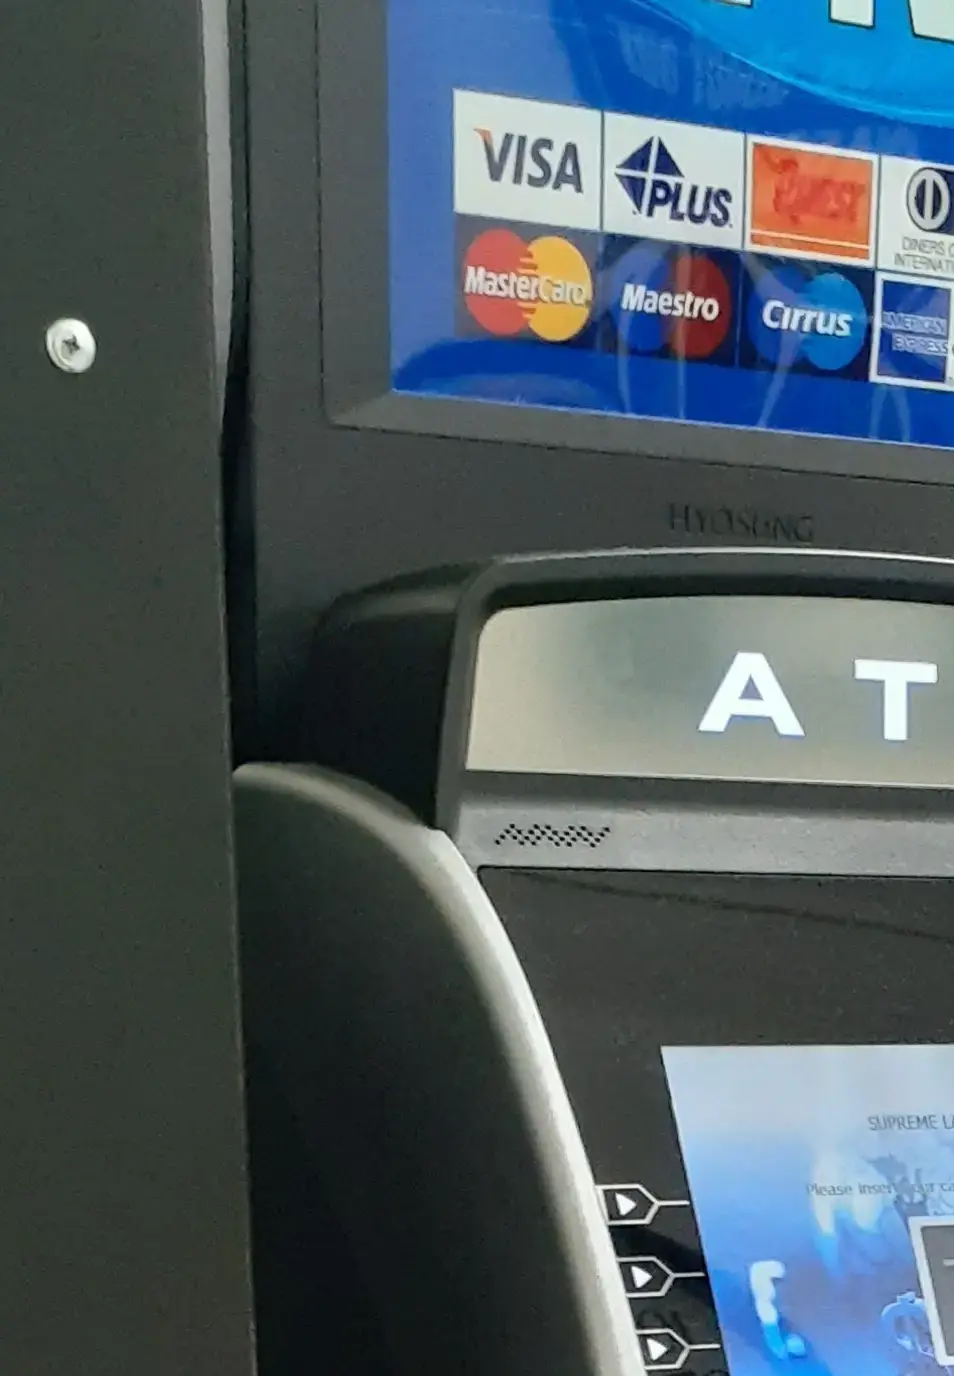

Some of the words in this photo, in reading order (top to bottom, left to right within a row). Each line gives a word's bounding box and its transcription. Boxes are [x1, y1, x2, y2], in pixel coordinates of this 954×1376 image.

[474, 128, 583, 194] VISA
[646, 179, 733, 228] PLUS
[464, 266, 590, 306] MasterCard
[621, 284, 719, 321] Maestro
[762, 300, 853, 336] Cirrus
[668, 503, 813, 542] HYOSUNG
[868, 1114, 940, 1131] SUPREME
[806, 1183, 852, 1197] Please
